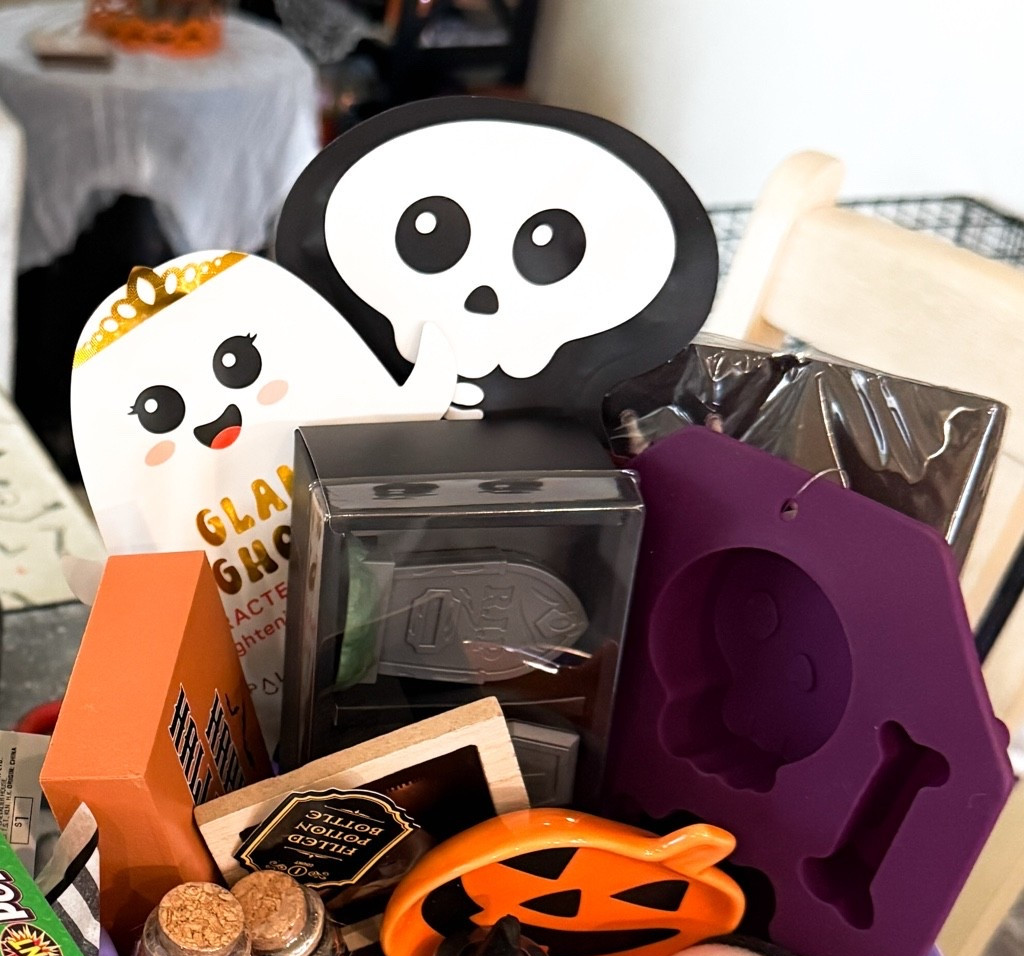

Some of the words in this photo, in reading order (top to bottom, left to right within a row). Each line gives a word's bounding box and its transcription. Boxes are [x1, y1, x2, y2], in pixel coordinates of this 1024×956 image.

[196, 465, 294, 546] GLA
[212, 525, 291, 595] GHO
[14, 816, 29, 828] $1
[294, 821, 372, 847] POTION
[305, 809, 385, 836] BOTTLE
[287, 833, 358, 857] FILLED
